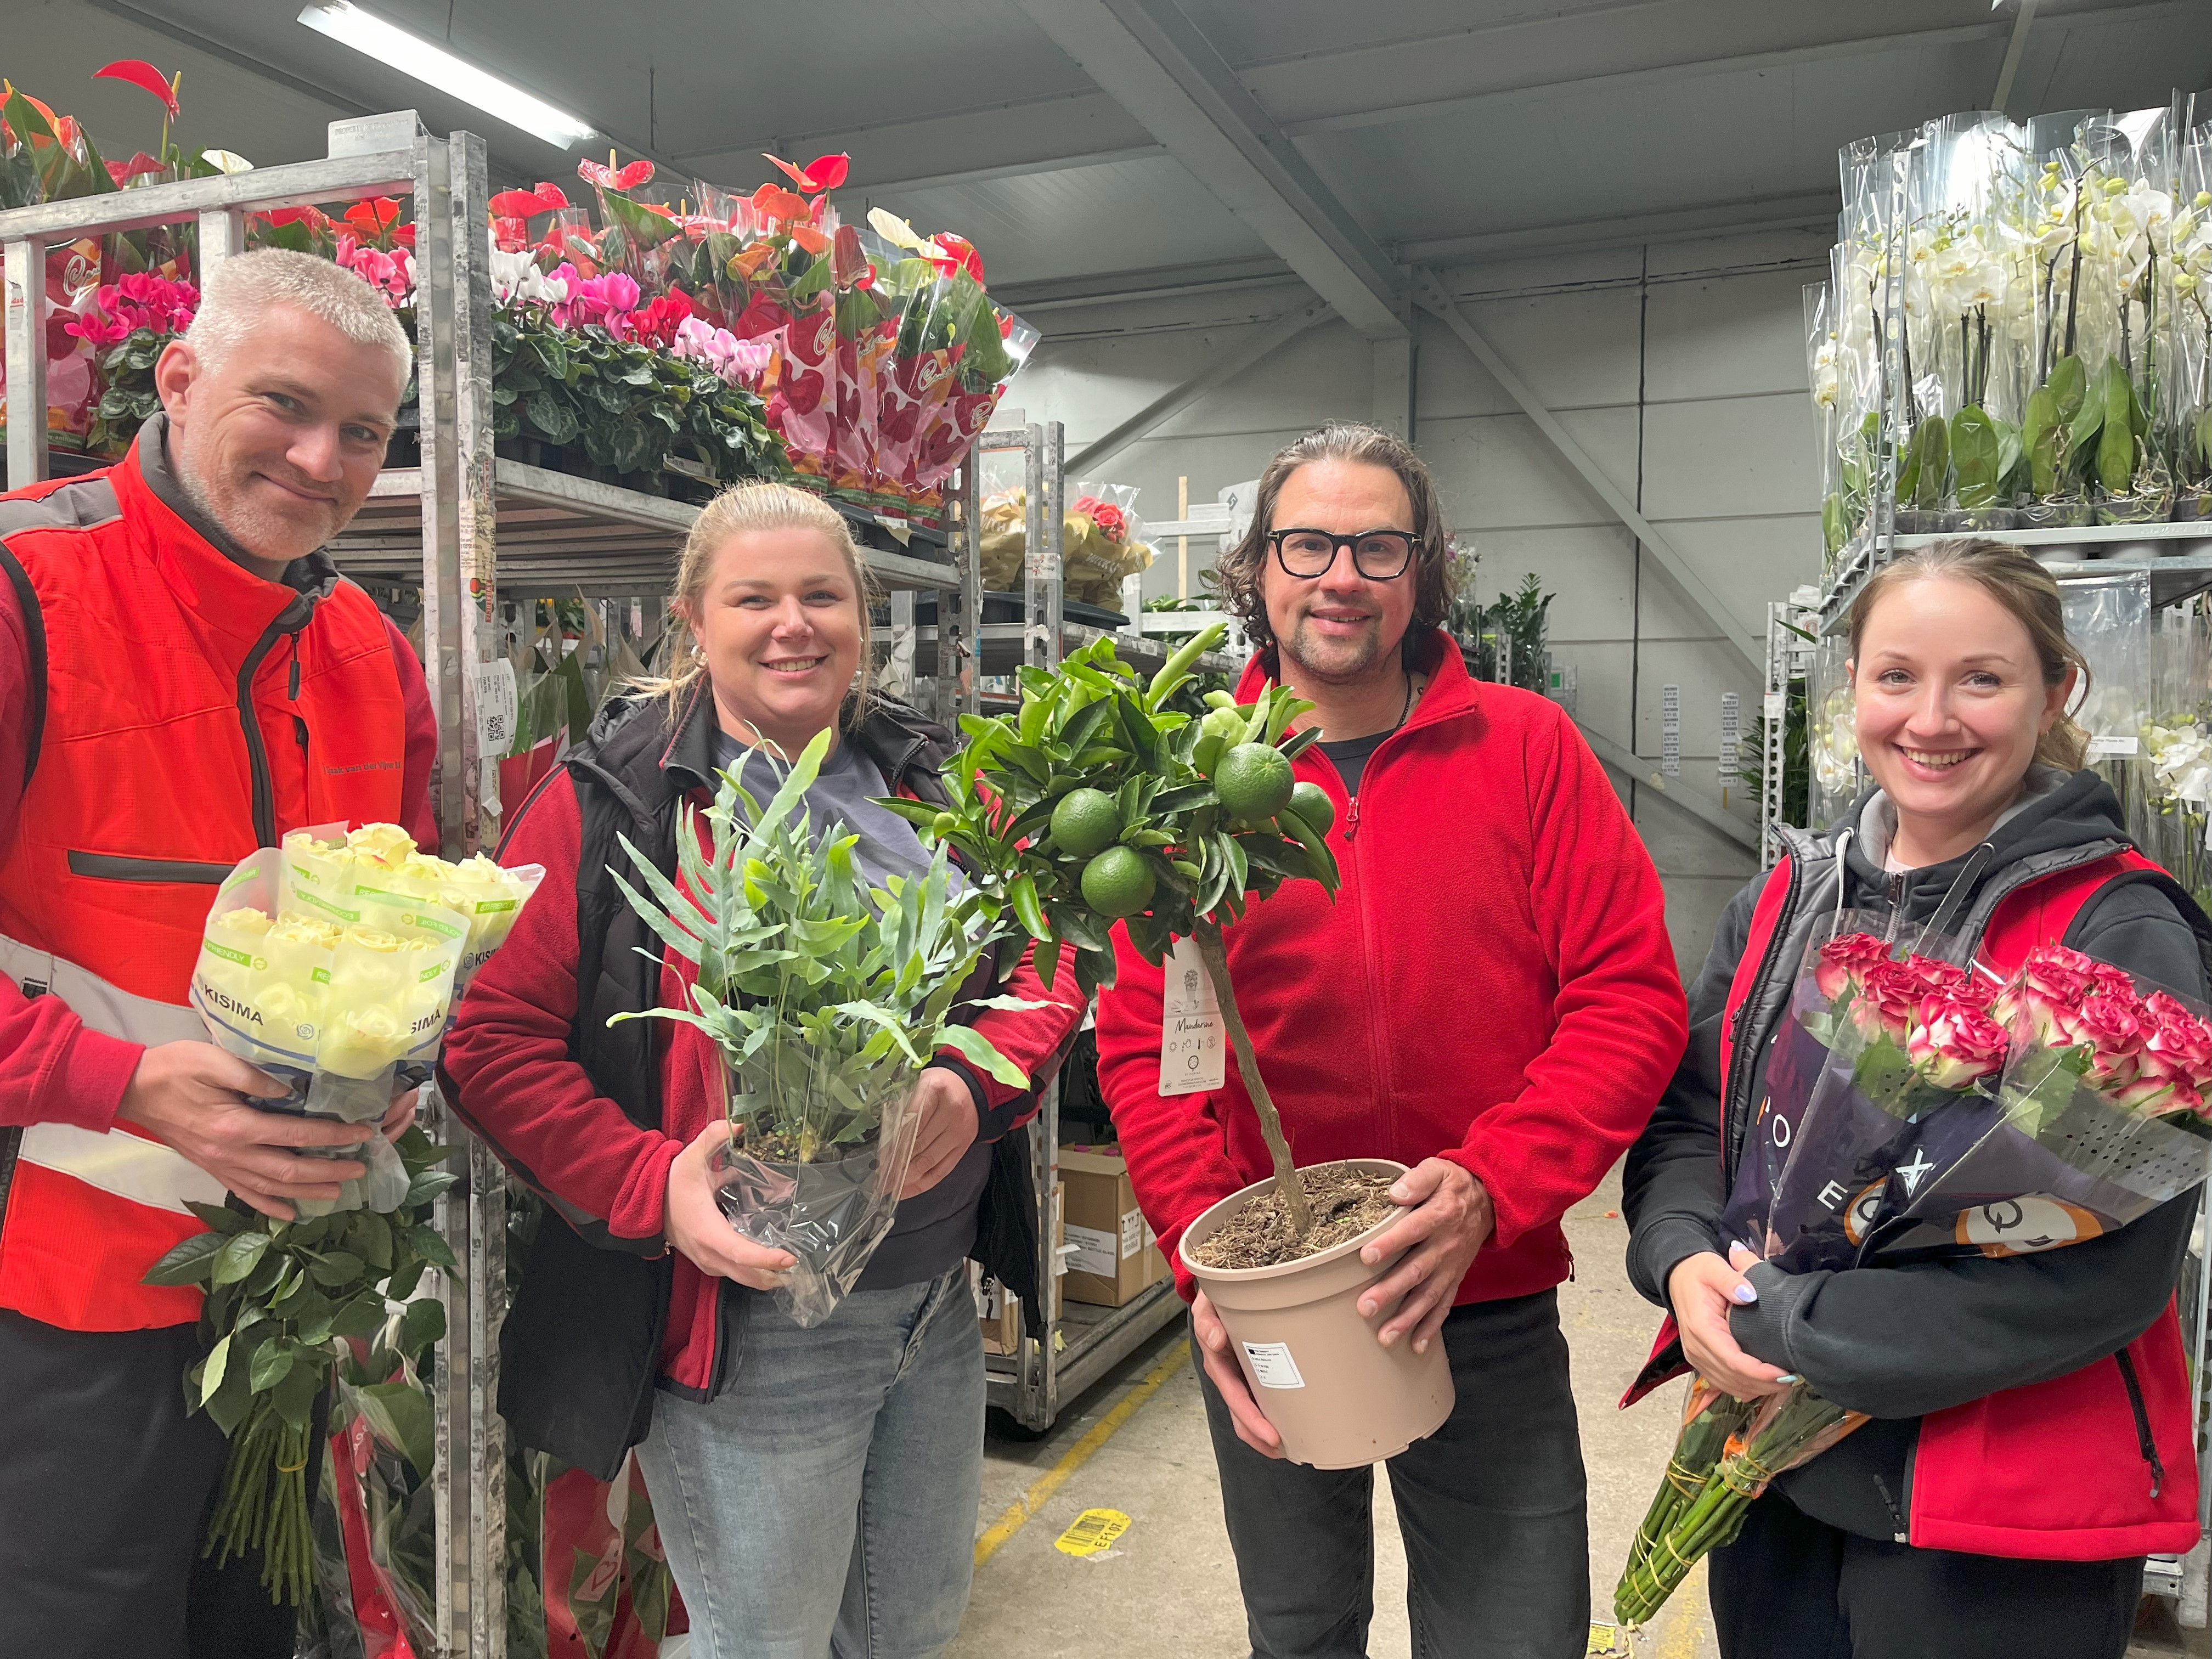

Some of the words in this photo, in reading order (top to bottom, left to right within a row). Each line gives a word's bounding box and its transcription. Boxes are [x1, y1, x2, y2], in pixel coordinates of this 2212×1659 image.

[207, 944, 245, 962] FRIENDLY
[205, 984, 264, 1026] KISIMA
[1175, 1017, 1214, 1034] Mandarine
[1816, 1179, 1849, 1210] E
